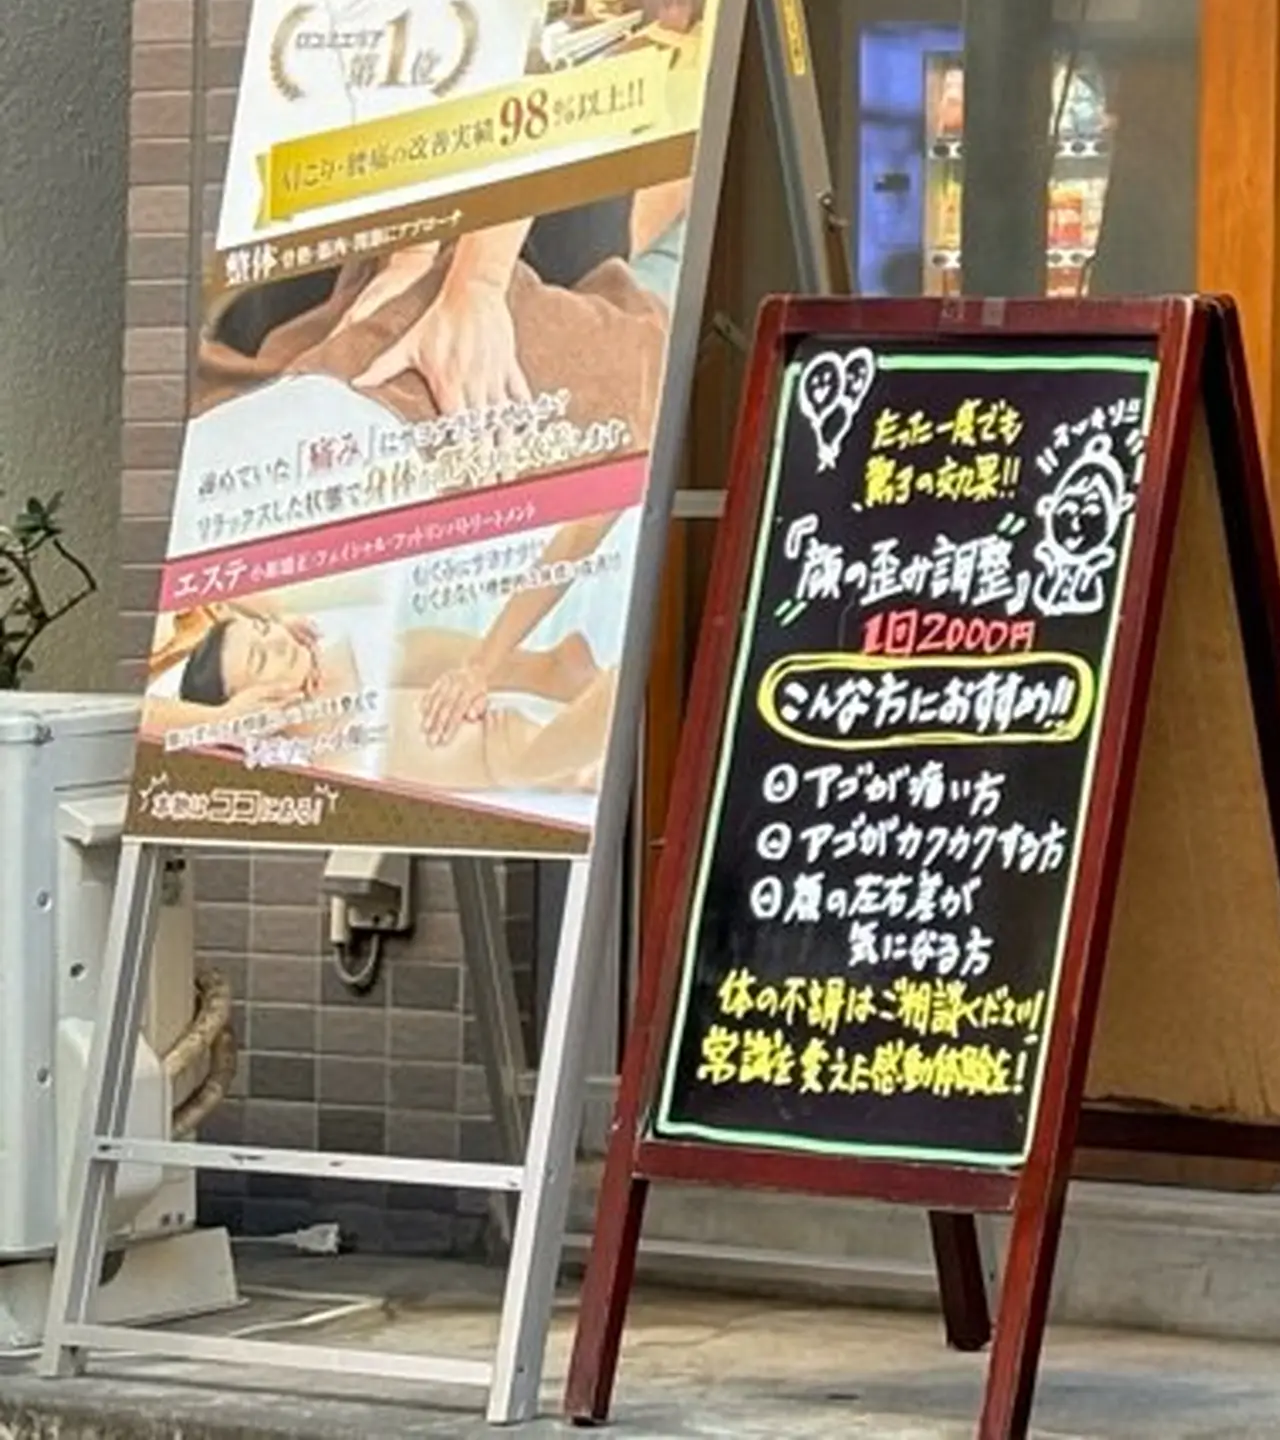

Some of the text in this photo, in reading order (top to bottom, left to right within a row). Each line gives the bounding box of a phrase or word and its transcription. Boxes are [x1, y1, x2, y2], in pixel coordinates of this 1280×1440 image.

[872, 398, 1023, 450] たった一度でも
[173, 560, 256, 599] エステ
[862, 609, 1035, 656] 1回2000円
[779, 670, 1076, 732] こんな方におすすめ!!
[803, 760, 1006, 817] アゴが痛い方
[799, 814, 1069, 873] アゴがカクカクする方
[784, 870, 983, 924] 顔の左右差が
[847, 920, 995, 977] 気になる方
